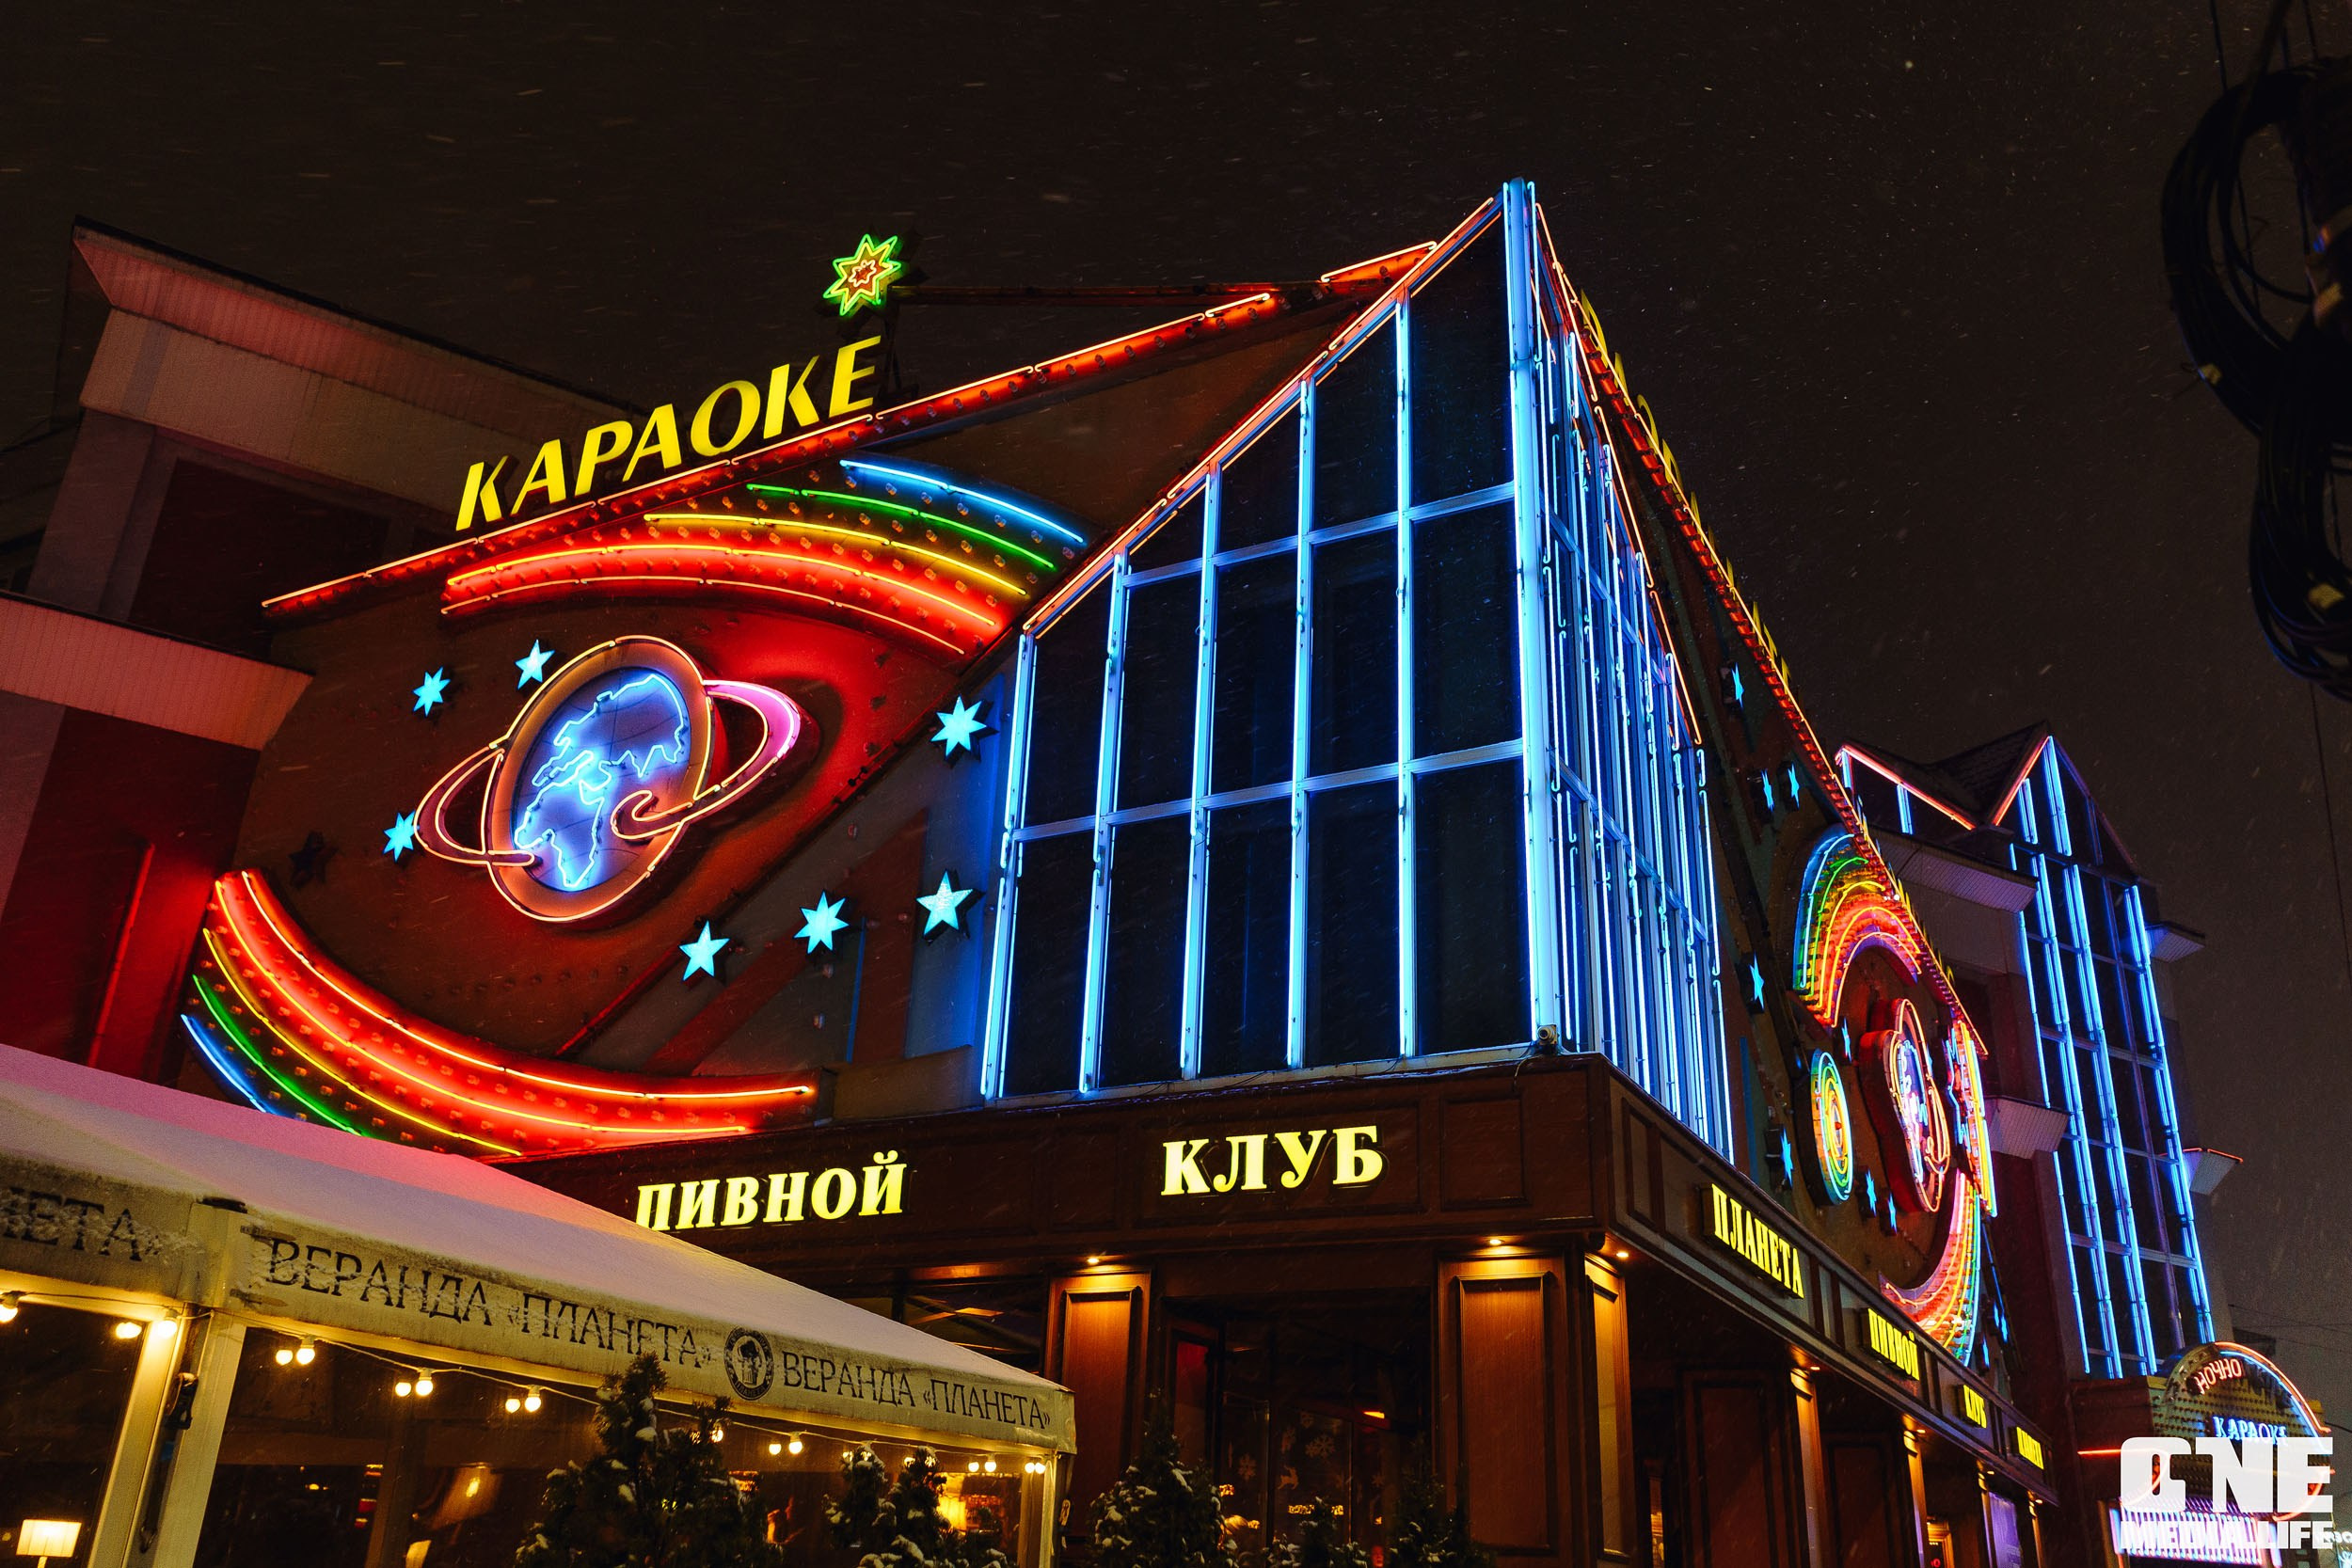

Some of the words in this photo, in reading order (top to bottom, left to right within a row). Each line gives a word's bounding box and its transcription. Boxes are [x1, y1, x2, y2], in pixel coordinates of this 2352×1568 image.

[455, 336, 881, 531] КАРАОКЕ
[636, 1150, 907, 1231] ПИВНОЙ
[1161, 1125, 1383, 1196] КЛУБ
[266, 1238, 492, 1326] ВЕРАНДА
[782, 1351, 915, 1407] ВЕРАНДА
[923, 1378, 1051, 1429] «ПЛАНЕТА»
[1711, 1183, 1804, 1299] ПЛАНЕТА
[1867, 1307, 1920, 1381] ПИВНОЙ
[2212, 1416, 2288, 1446] КАРАОКЕ
